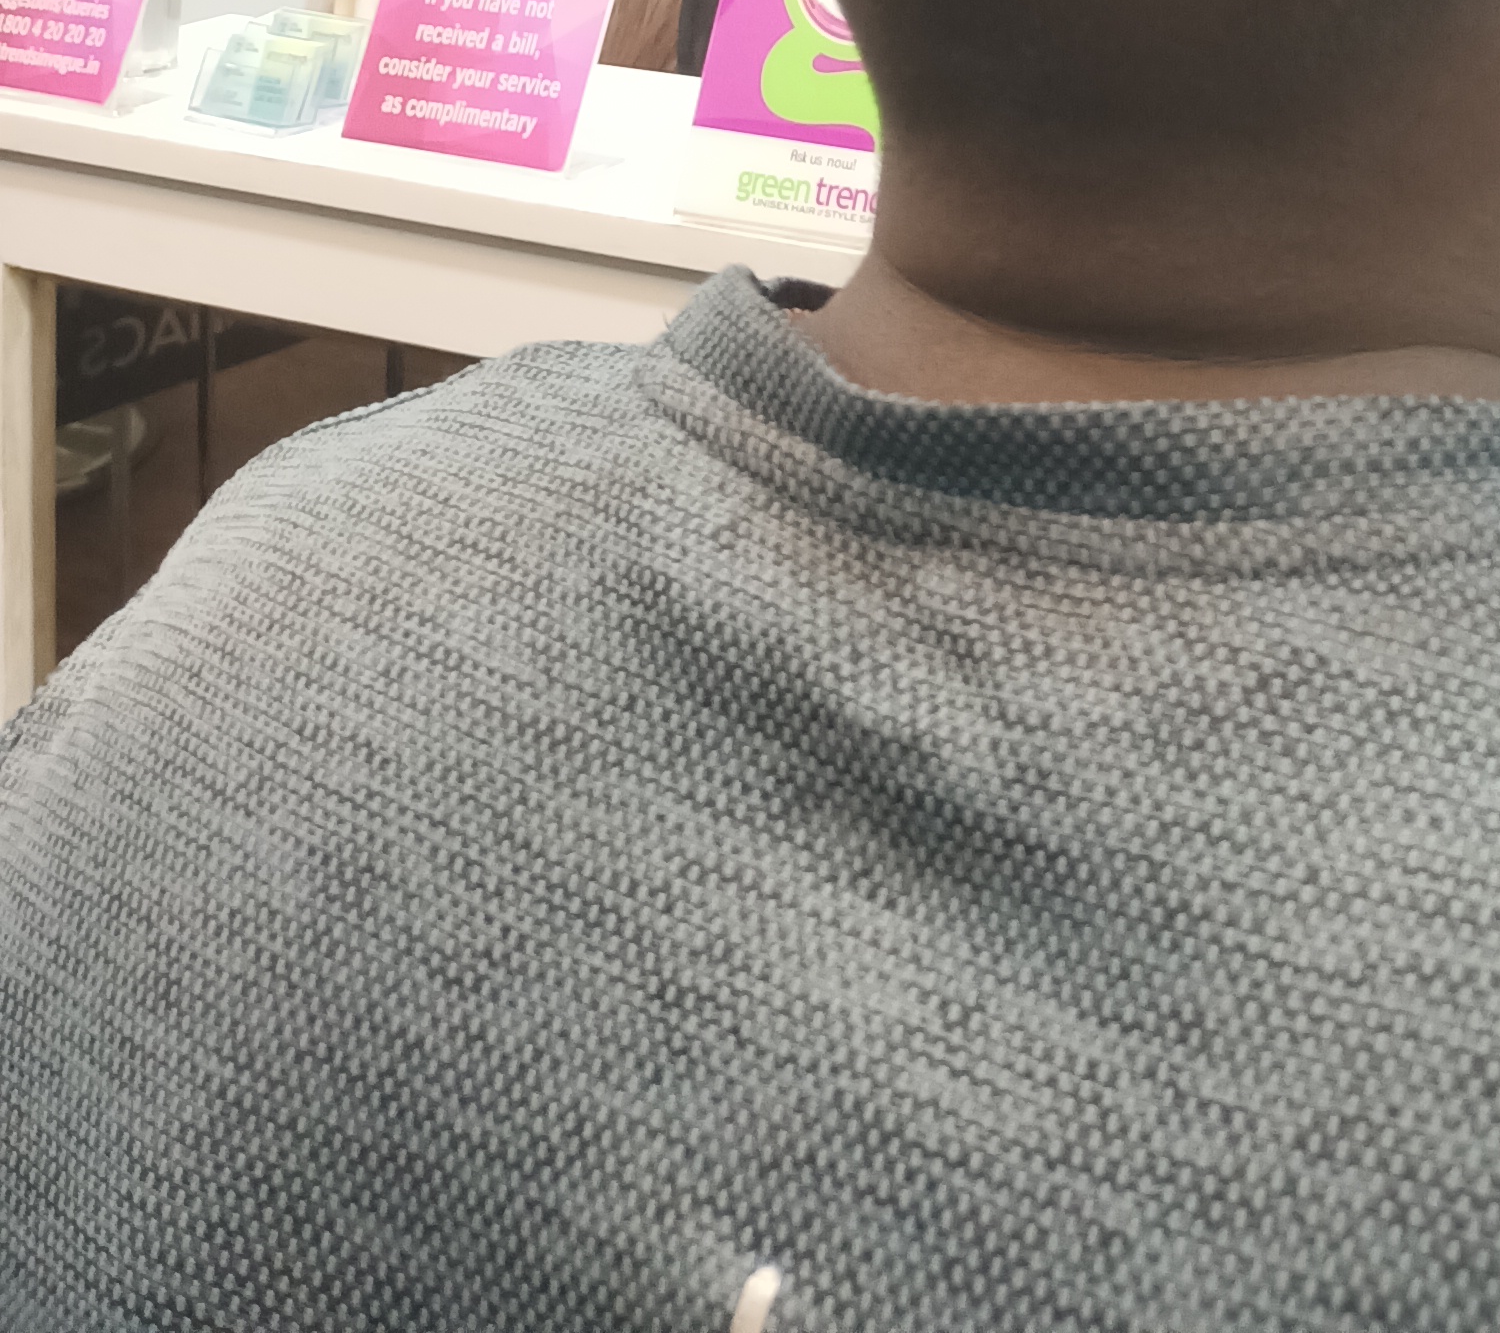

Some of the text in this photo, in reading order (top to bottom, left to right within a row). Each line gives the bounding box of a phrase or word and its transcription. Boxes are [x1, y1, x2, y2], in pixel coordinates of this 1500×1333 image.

[524, 0, 556, 20] not
[31, 19, 44, 37] 4
[43, 20, 64, 41] 20
[64, 23, 86, 44] 20
[85, 26, 106, 47] 20
[415, 23, 540, 60] received a bill,
[378, 56, 562, 99] consider your service
[380, 94, 538, 139] as complimentary
[790, 148, 857, 171] Ask us now!
[735, 170, 878, 215] green tren
[753, 198, 789, 211] UNISEX
[791, 205, 816, 215] HAIR
[824, 210, 857, 223] STYLE
